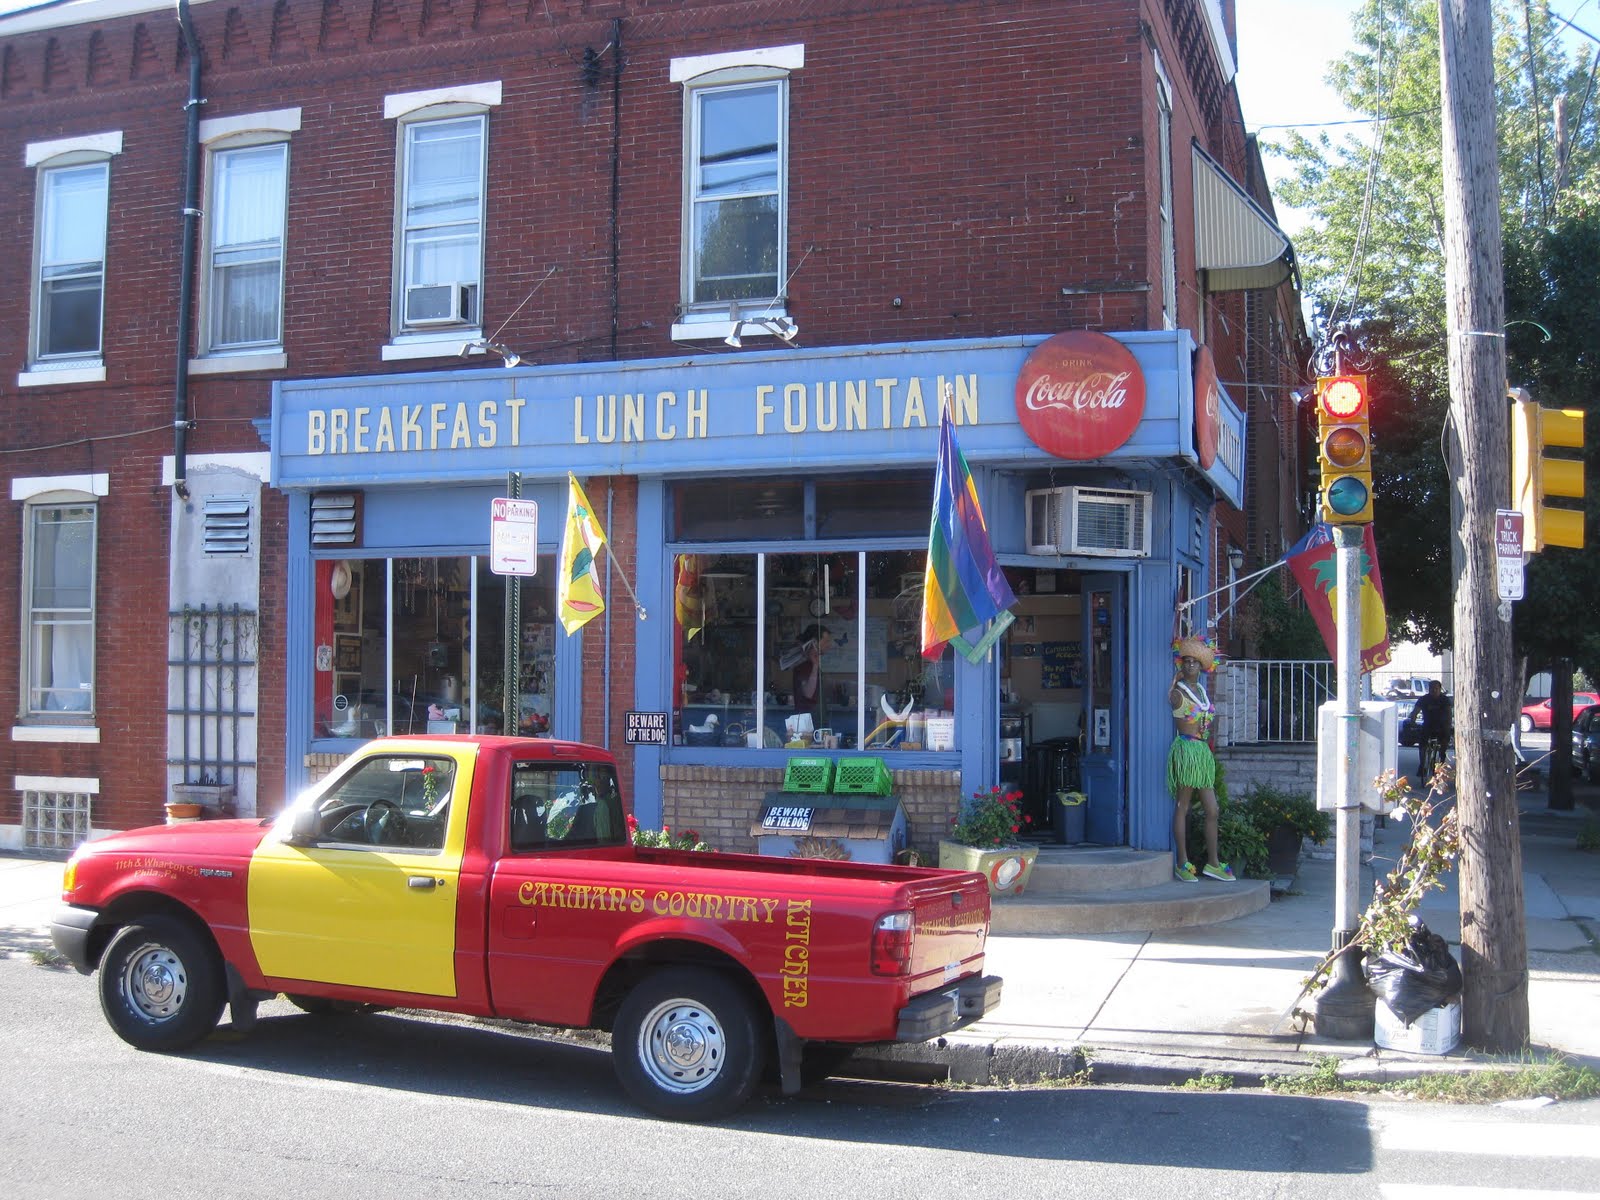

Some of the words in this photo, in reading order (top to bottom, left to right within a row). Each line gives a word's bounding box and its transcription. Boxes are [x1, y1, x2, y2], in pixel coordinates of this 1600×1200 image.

[1062, 359, 1093, 368] DRINK
[308, 398, 526, 455] BREAKFAST
[574, 389, 708, 445] LUNCH
[755, 373, 979, 435] FOUNTAIN
[494, 503, 506, 518] NO
[507, 506, 535, 518] PARKING
[1503, 518, 1512, 530] NO
[1500, 530, 1518, 543] TRUCK
[1498, 543, 1521, 555] PARKING
[629, 714, 664, 728] BEWARE
[628, 728, 638, 741] OF
[638, 728, 651, 741] THE
[651, 728, 666, 742] DOG
[769, 806, 810, 817] BEWARE
[765, 816, 777, 827] OF
[776, 816, 791, 828] THE
[791, 816, 809, 829] DOG
[115, 858, 133, 870] 11th
[134, 858, 143, 868] &
[144, 857, 185, 873] Wharton
[518, 881, 645, 913] CARMAN'S
[653, 890, 779, 923] COUNTRY
[780, 899, 812, 1008] KITCHEN
